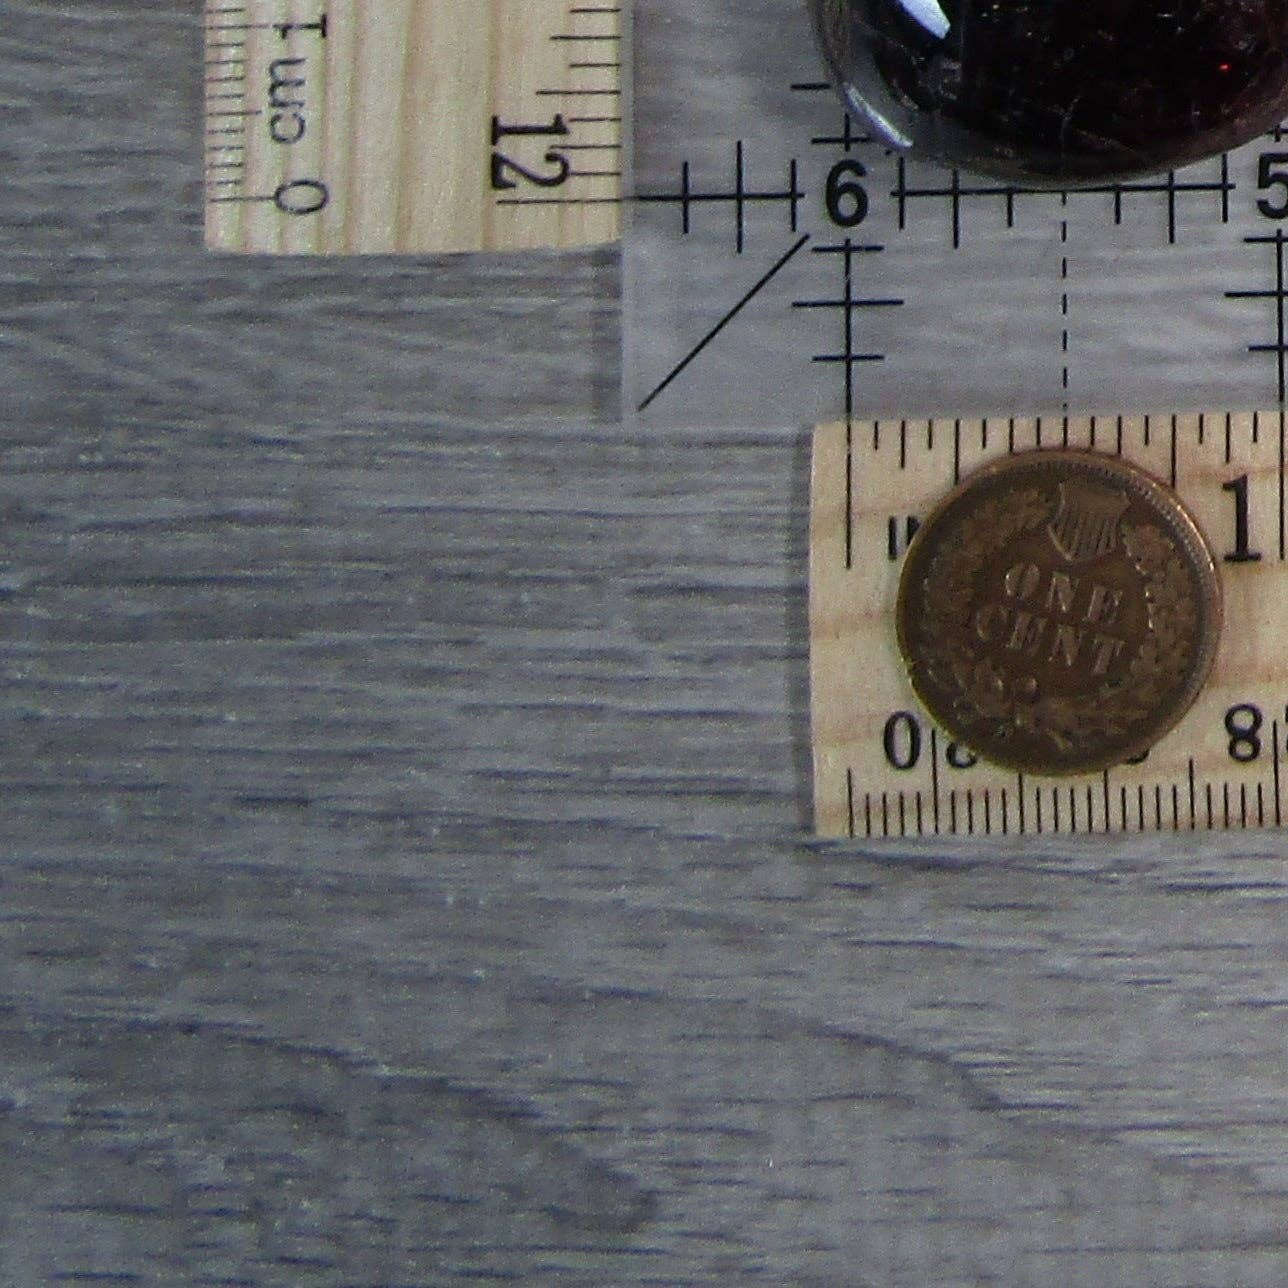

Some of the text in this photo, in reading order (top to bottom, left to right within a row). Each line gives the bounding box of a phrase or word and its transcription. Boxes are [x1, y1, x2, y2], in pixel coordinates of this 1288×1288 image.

[280, 12, 329, 39] 1
[266, 55, 307, 144] cm
[491, 112, 571, 191] 12
[273, 180, 329, 216] 0
[825, 158, 870, 229] 6
[1223, 475, 1263, 563] 1
[1005, 563, 1124, 625] ONE
[976, 605, 1126, 674] CENT
